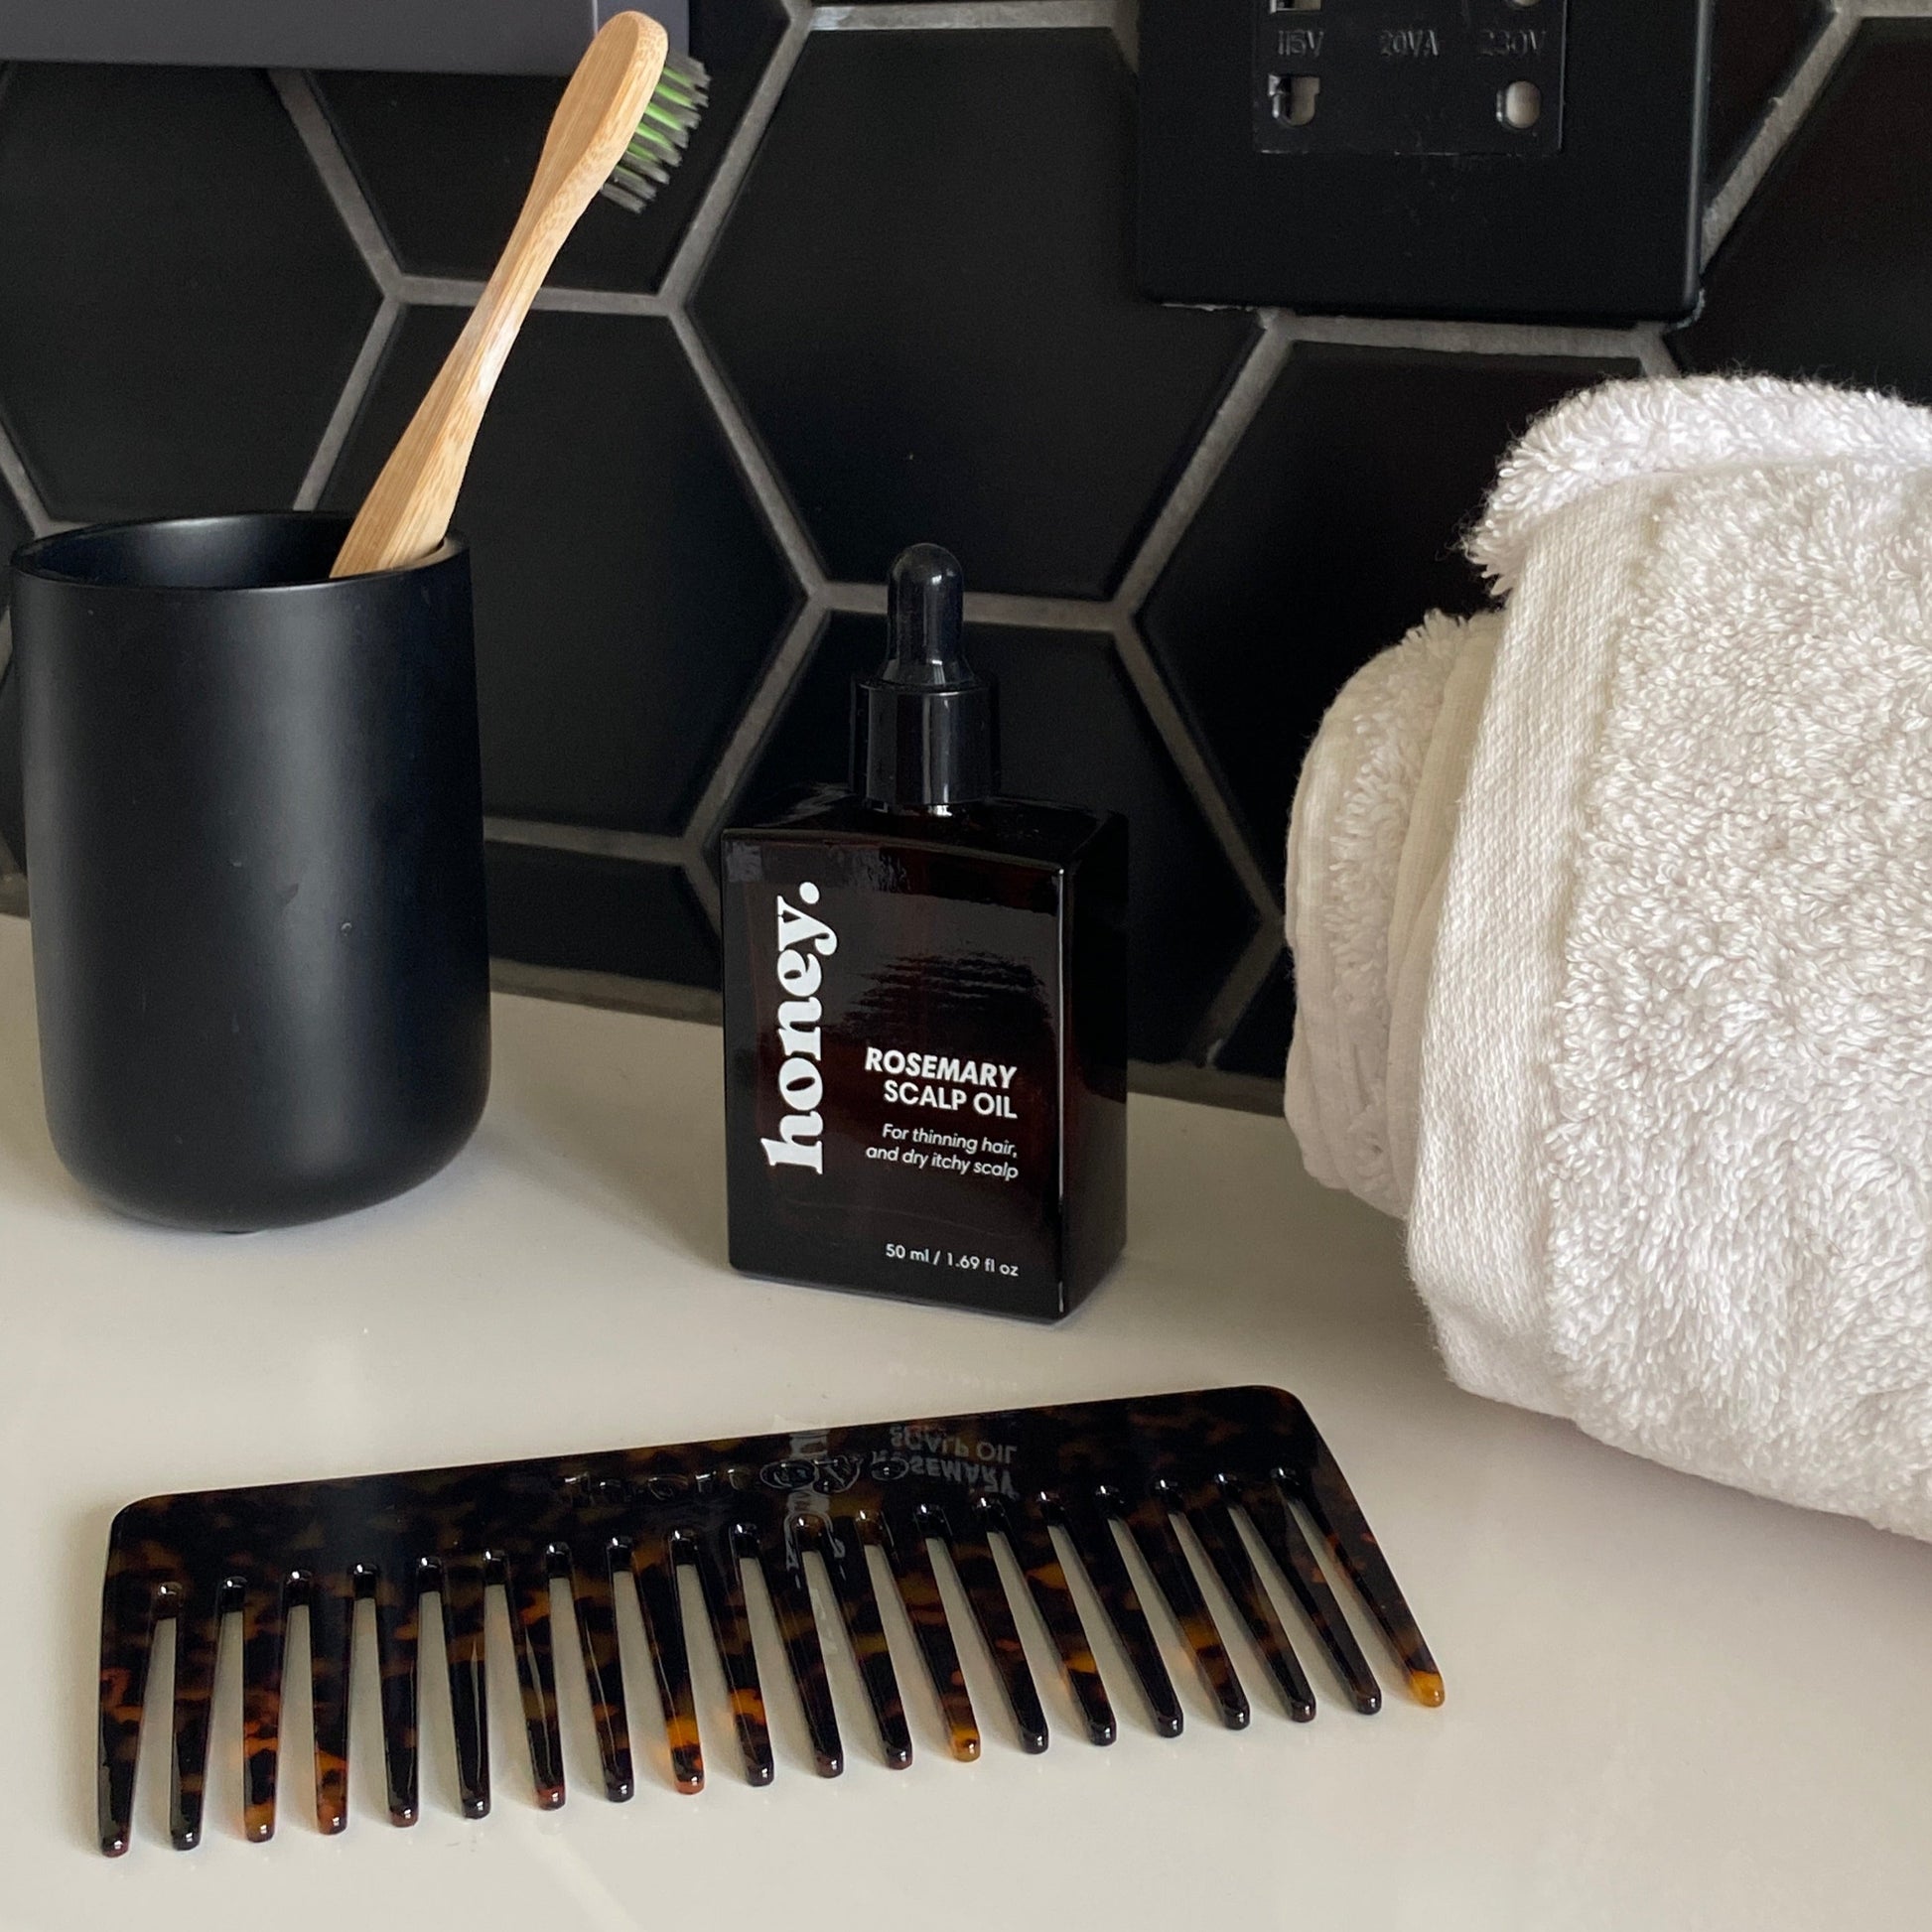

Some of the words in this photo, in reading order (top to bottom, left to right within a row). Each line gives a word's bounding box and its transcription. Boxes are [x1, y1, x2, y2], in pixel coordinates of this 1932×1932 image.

[1278, 29, 1324, 57] 115V
[1379, 29, 1439, 57] 20VA
[1479, 29, 1547, 57] 230V
[760, 882, 838, 1175] honey.
[865, 1046, 1018, 1089] ROSEMARY
[884, 1079, 967, 1111] SCALP
[973, 1092, 1018, 1119] OIL
[882, 1123, 909, 1141] For
[912, 1128, 978, 1155] thinning
[981, 1137, 1018, 1158] hair,
[866, 1146, 899, 1162] and
[902, 1149, 928, 1169] dry
[931, 1152, 970, 1174] itchy
[973, 1162, 1019, 1181] scalp
[886, 1243, 905, 1259] 50
[909, 1249, 929, 1263] ml
[933, 1251, 941, 1266] /
[947, 1252, 980, 1270] 1.69
[984, 1258, 996, 1273] fl
[999, 1264, 1019, 1277] oz
